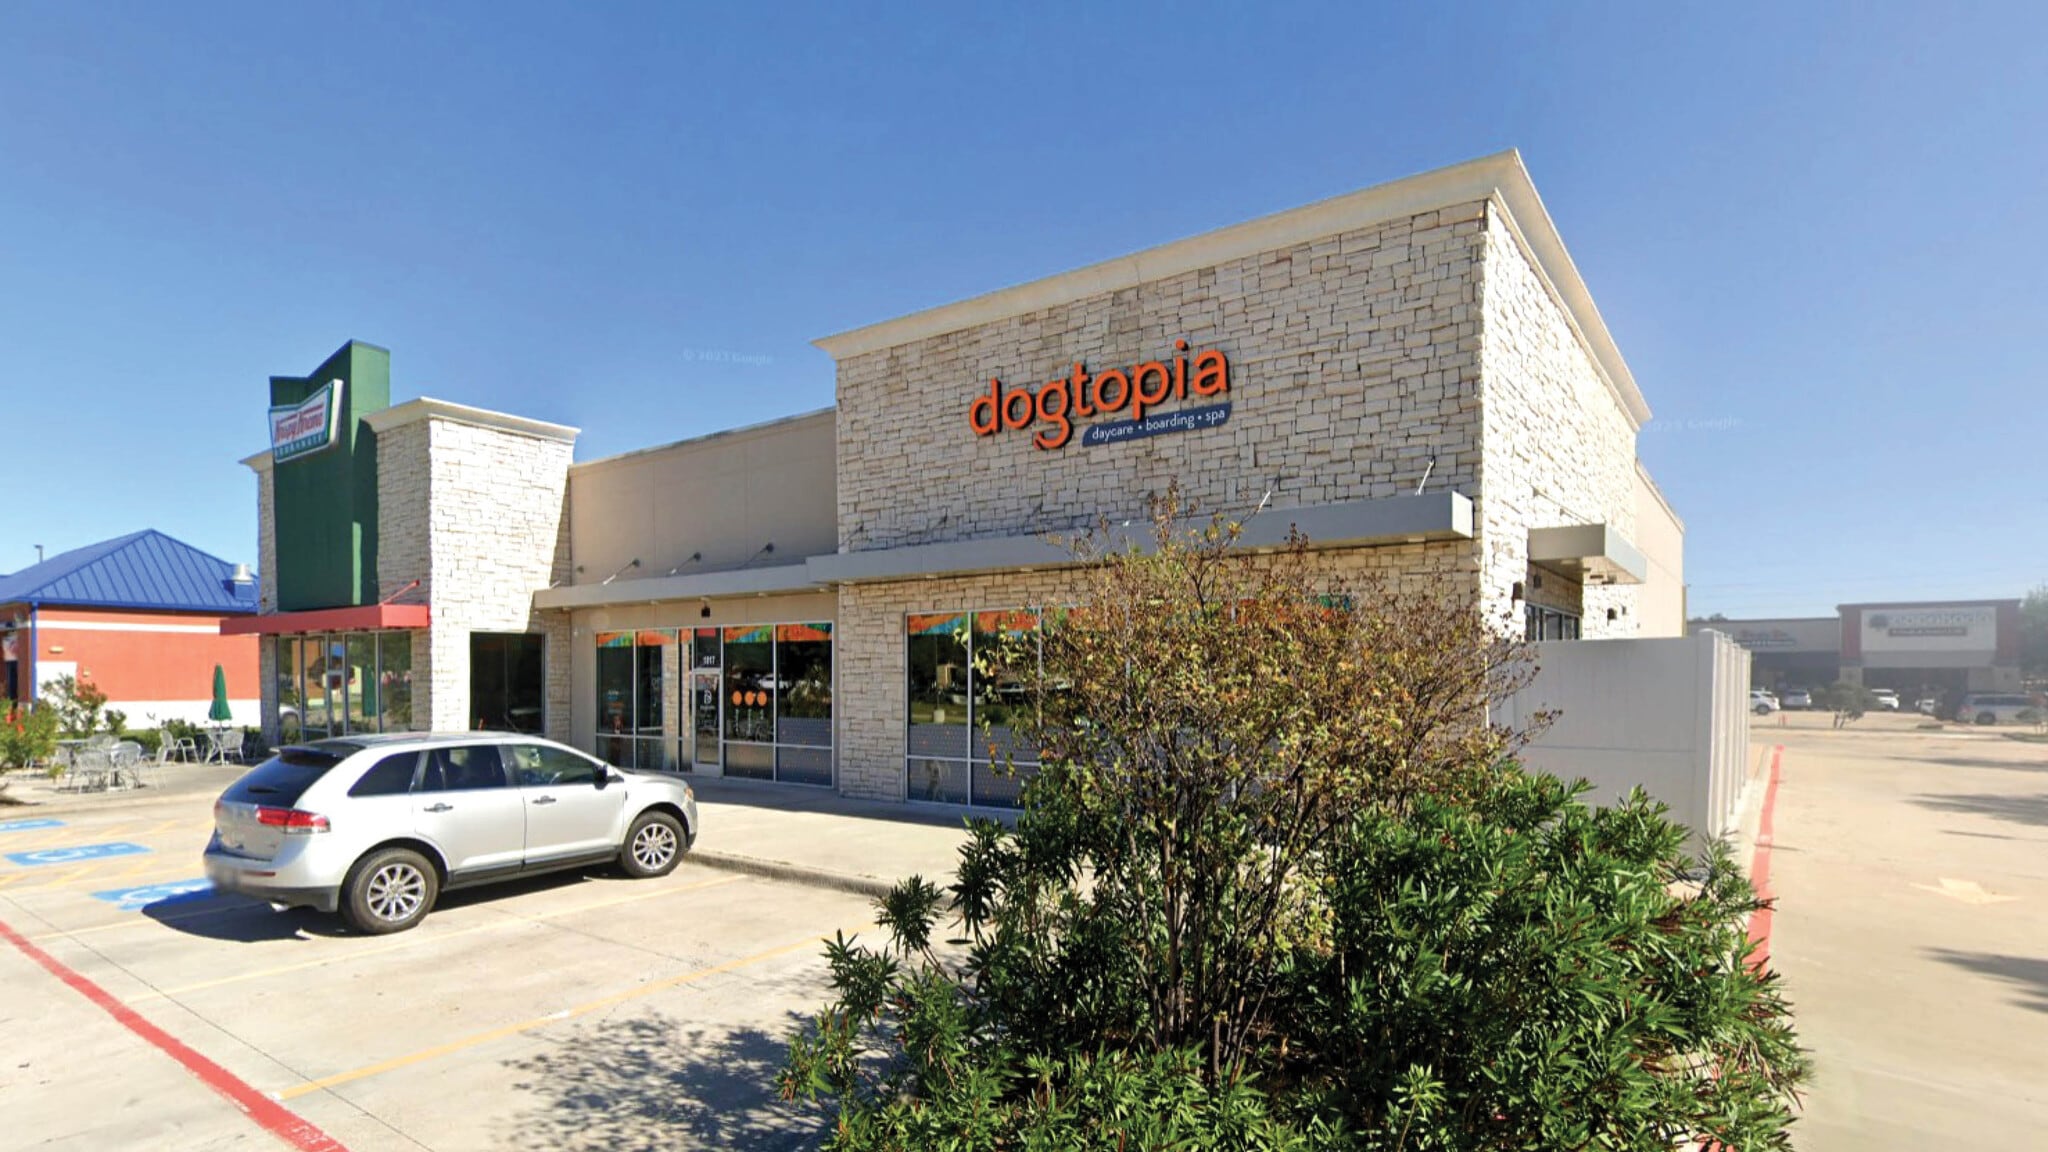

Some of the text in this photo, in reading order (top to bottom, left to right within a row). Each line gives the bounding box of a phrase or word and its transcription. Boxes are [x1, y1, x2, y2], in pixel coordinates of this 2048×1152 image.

[968, 338, 1230, 449] dogtopia
[1091, 409, 1226, 442] daycare boarding spa
